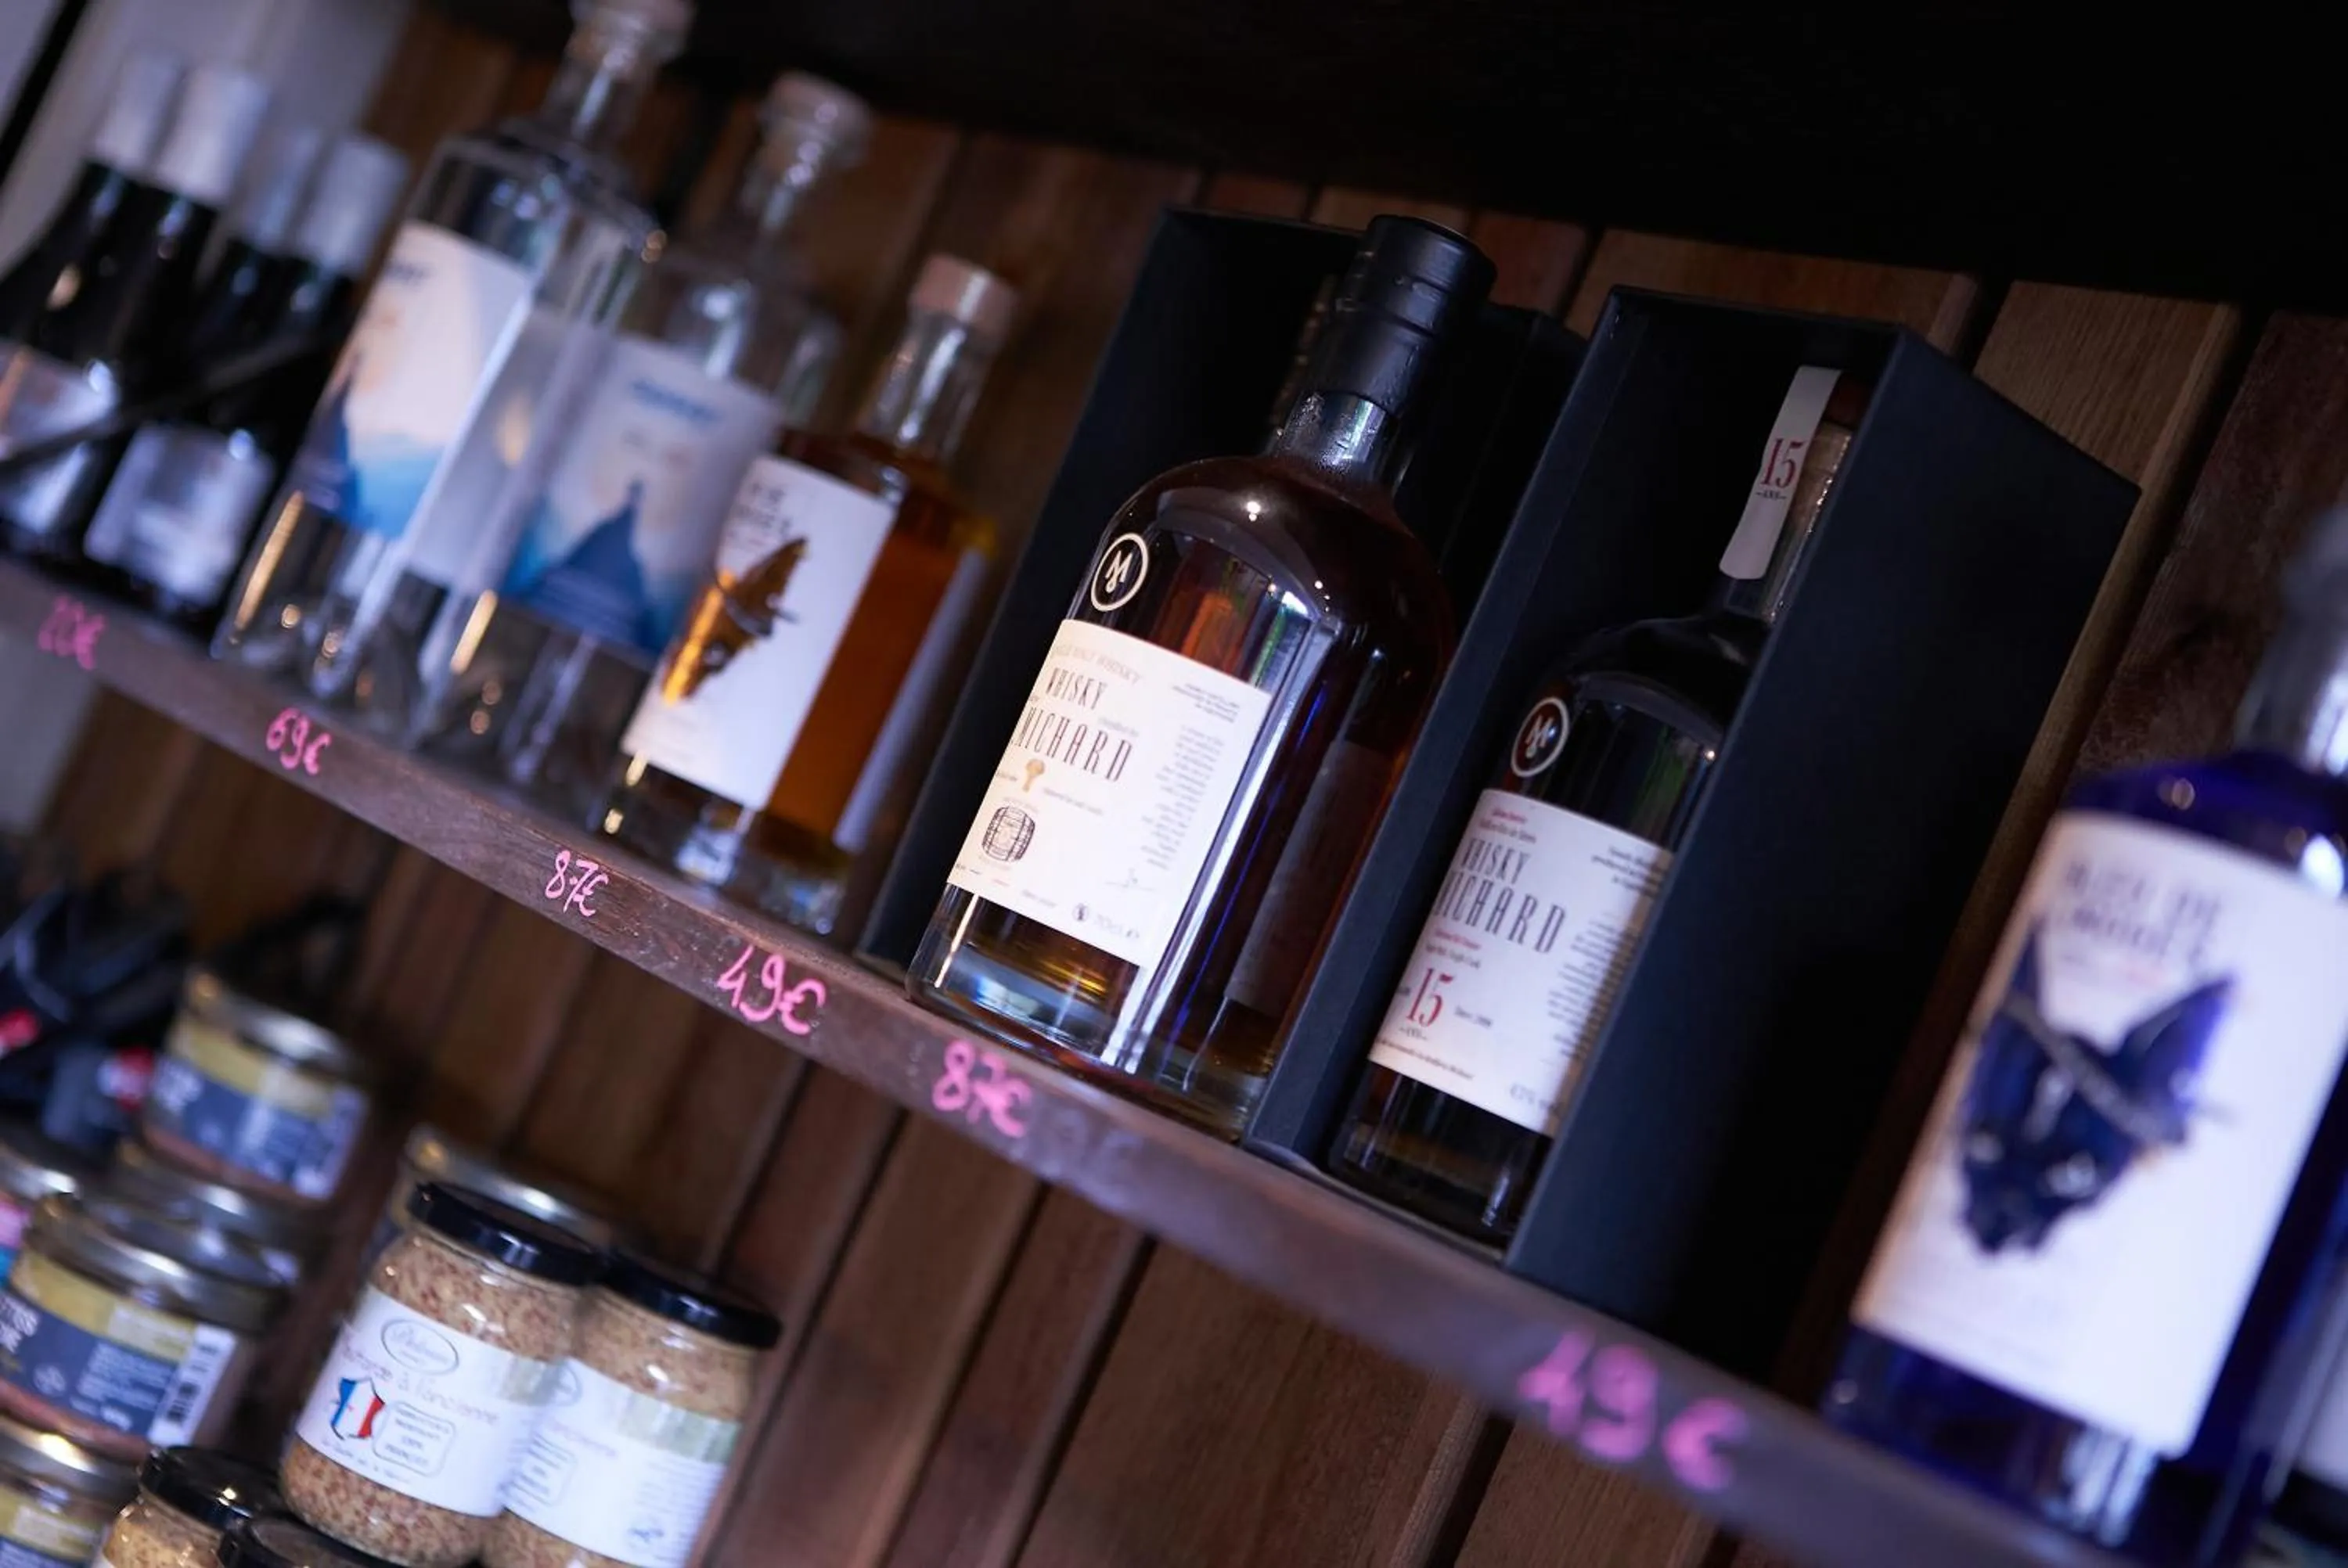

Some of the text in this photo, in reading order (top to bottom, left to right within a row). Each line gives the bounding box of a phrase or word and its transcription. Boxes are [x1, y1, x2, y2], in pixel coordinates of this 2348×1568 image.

[1760, 437, 1809, 489] 15
[266, 707, 333, 775] 69€
[716, 944, 826, 1035] 49€
[1406, 967, 1456, 1028] 15
[1516, 1325, 1752, 1494] 49€
